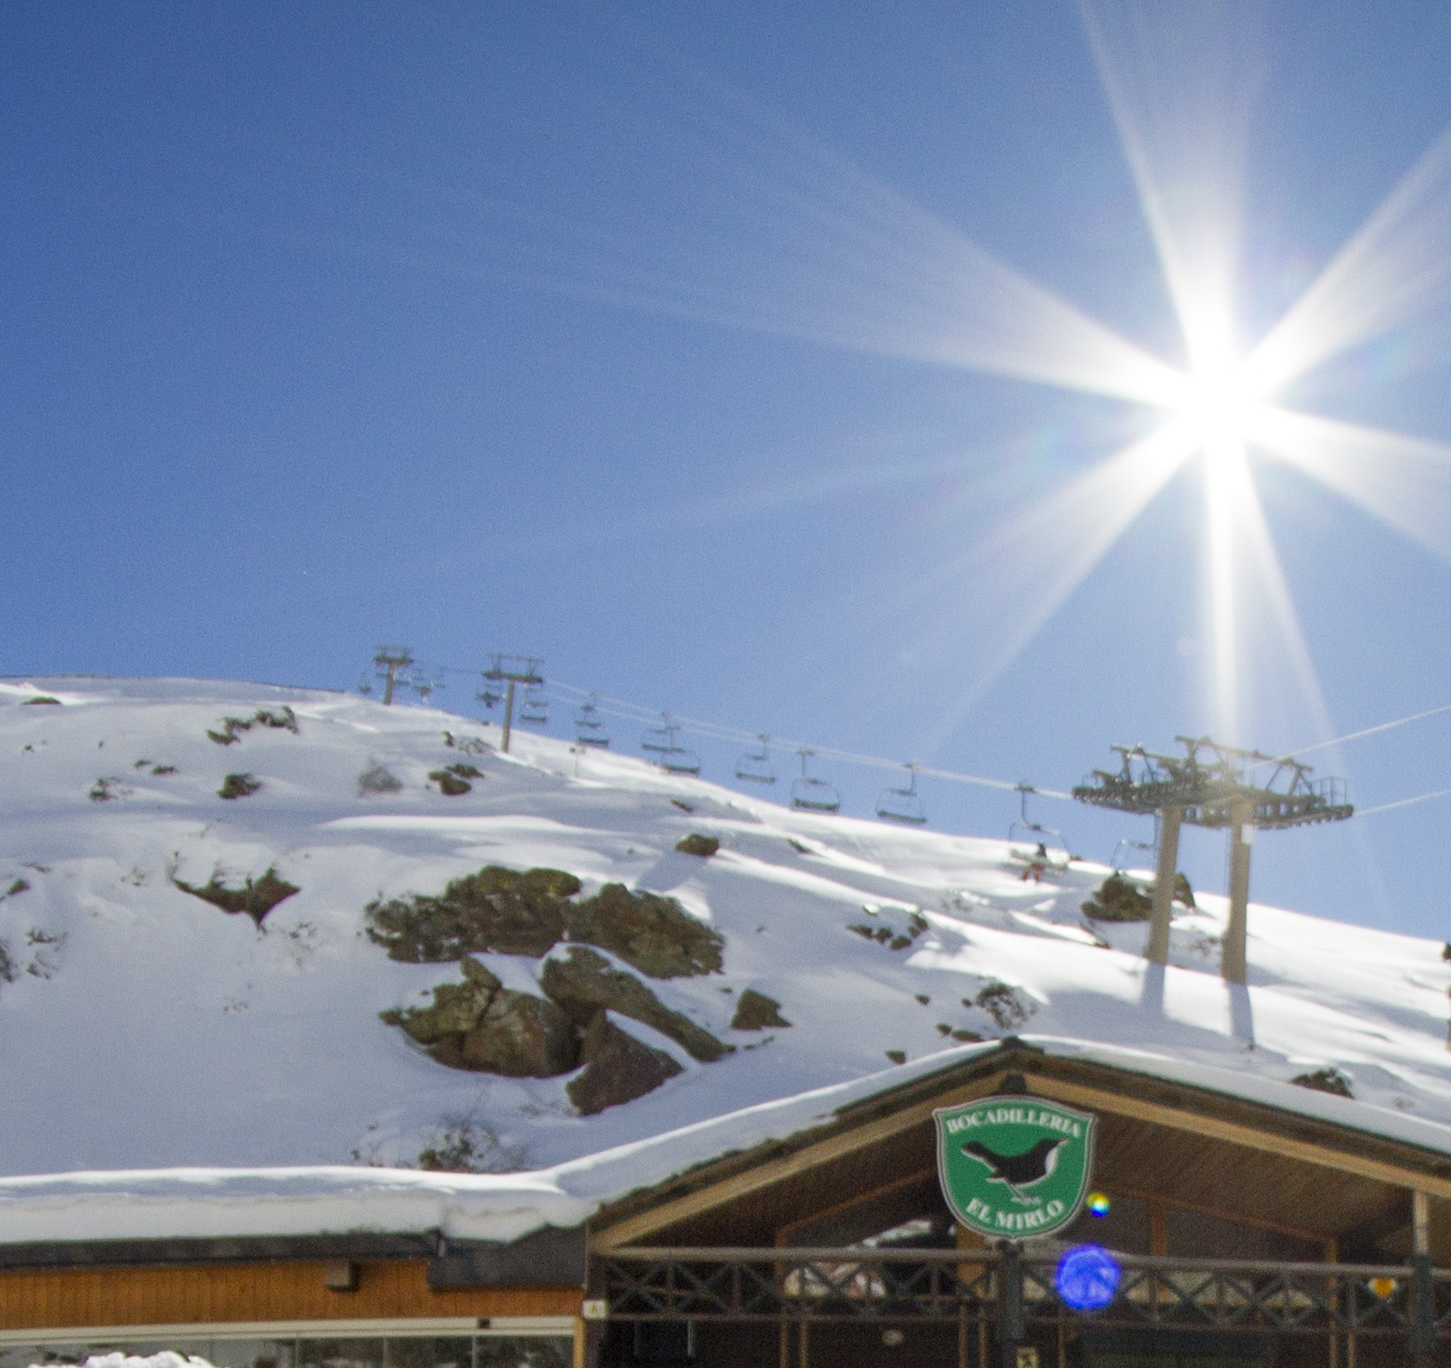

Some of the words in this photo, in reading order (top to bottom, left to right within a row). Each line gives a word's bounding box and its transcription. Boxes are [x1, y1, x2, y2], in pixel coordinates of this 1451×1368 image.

[946, 1108, 1081, 1138] BOCADILLERIA
[966, 1198, 991, 1222] EL
[995, 1200, 1064, 1230] MIRLO
